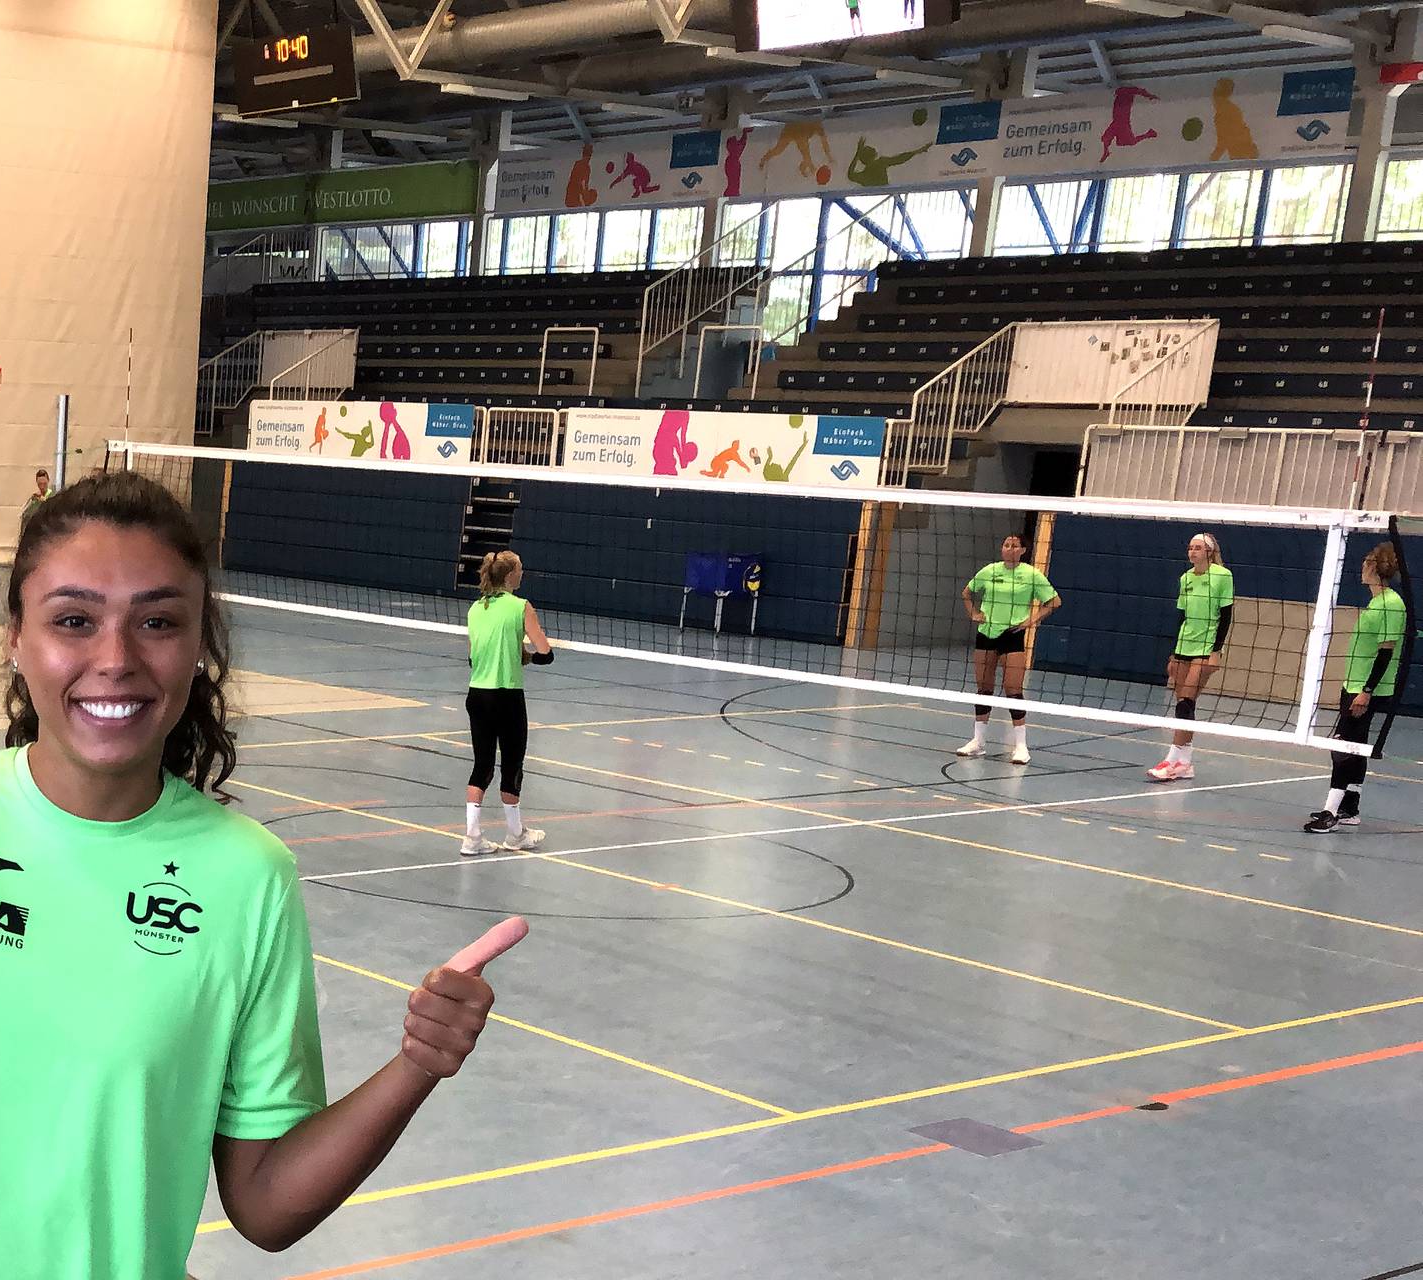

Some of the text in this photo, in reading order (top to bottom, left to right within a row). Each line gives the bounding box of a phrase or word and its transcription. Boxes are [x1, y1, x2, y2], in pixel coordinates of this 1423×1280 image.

[276, 35, 309, 63] 10:40
[1006, 119, 1092, 139] Gemeinsam
[1003, 138, 1087, 159] zum Erfolg.
[256, 418, 305, 433] Gemeinsam
[256, 434, 302, 452] zum Erfolg.
[574, 429, 642, 447] Gemeinsam
[572, 448, 637, 468] zum Erfolg.
[126, 891, 203, 934] USC
[134, 928, 185, 945] MÜNSTER
